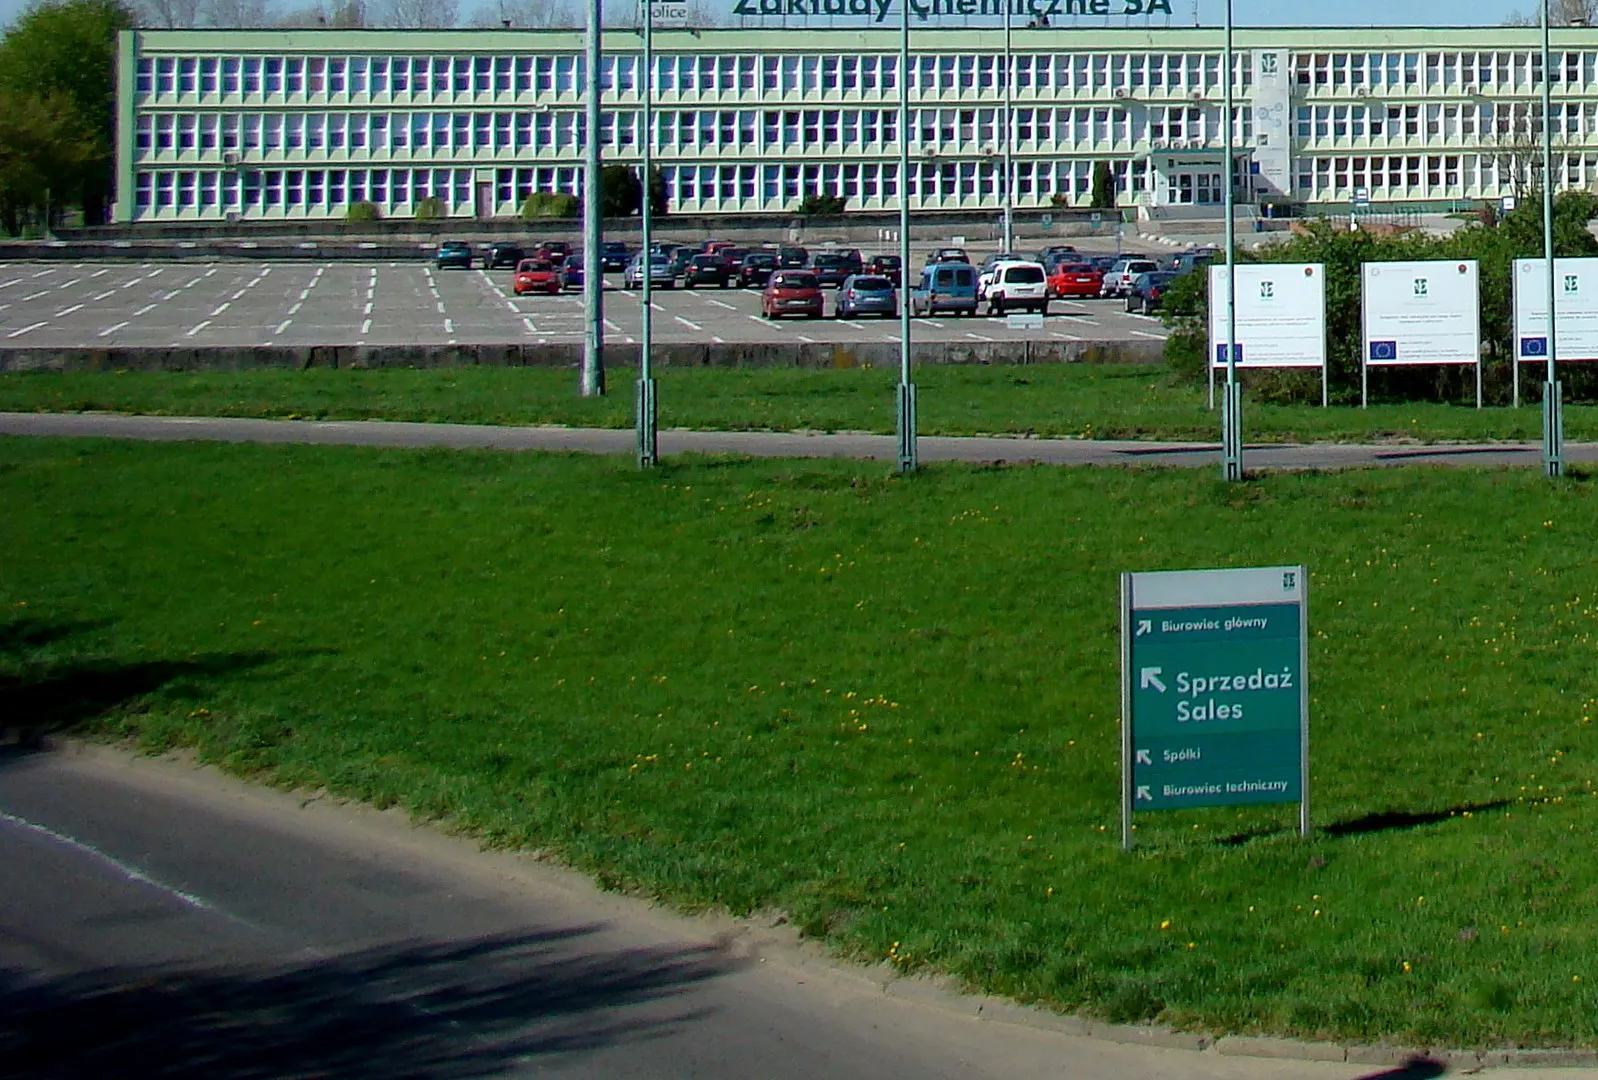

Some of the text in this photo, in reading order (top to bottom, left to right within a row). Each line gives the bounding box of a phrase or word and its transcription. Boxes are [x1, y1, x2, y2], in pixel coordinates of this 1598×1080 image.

[1162, 617, 1221, 633] Biurowiec
[1176, 666, 1293, 699] Sprzedaż
[1177, 698, 1243, 722] Sales
[1163, 779, 1288, 797] Biurowiec techniczny
